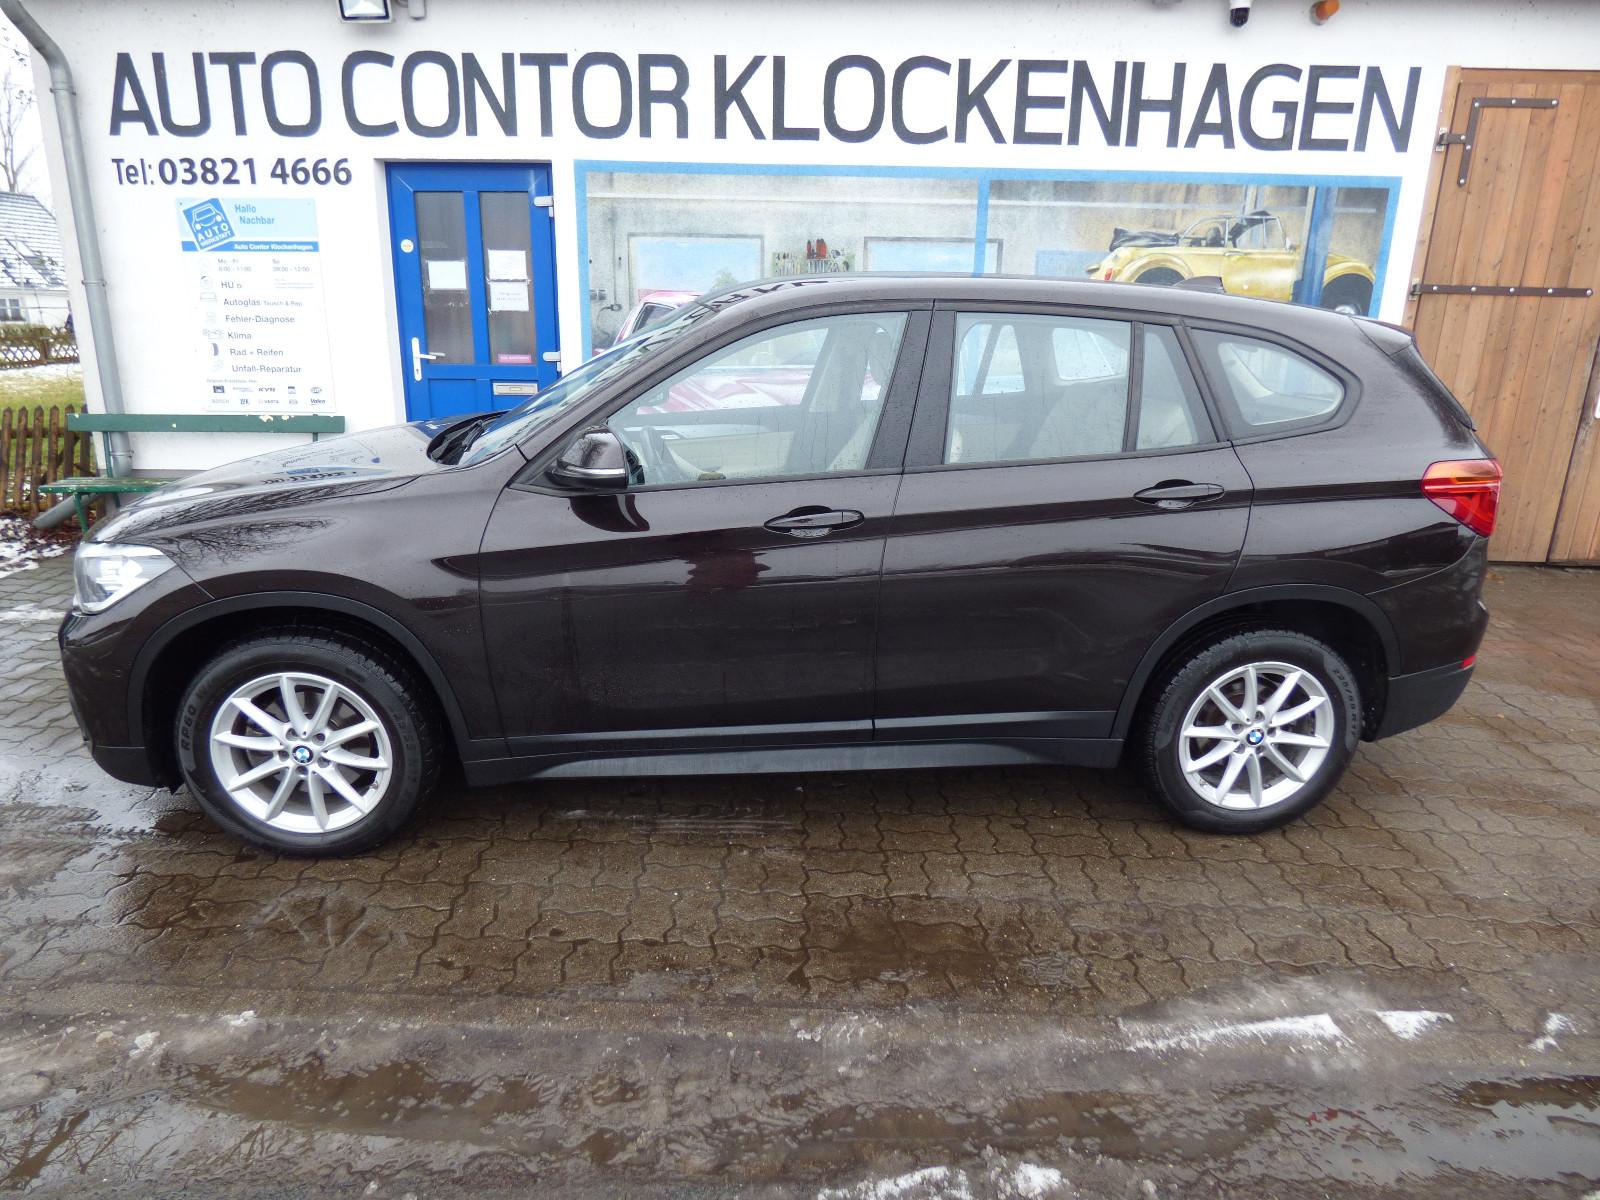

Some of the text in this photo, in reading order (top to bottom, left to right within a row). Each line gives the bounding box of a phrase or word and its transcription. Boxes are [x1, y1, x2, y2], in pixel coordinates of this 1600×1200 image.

[109, 49, 1422, 153] AUTO CONTOR KLOCKENHAGEN
[112, 157, 352, 186] Tel: 03821 4666
[234, 203, 257, 213] Hallo
[239, 215, 275, 225] Nachbar
[198, 223, 228, 242] AUTO
[221, 280, 234, 289] HU
[223, 298, 261, 308] Autoglas
[225, 314, 296, 325] Fehler-Diagnose
[227, 331, 252, 340] Klima
[229, 348, 247, 356] Rad
[256, 348, 284, 356] Reifen
[231, 365, 302, 374] Unfall-Reparatur
